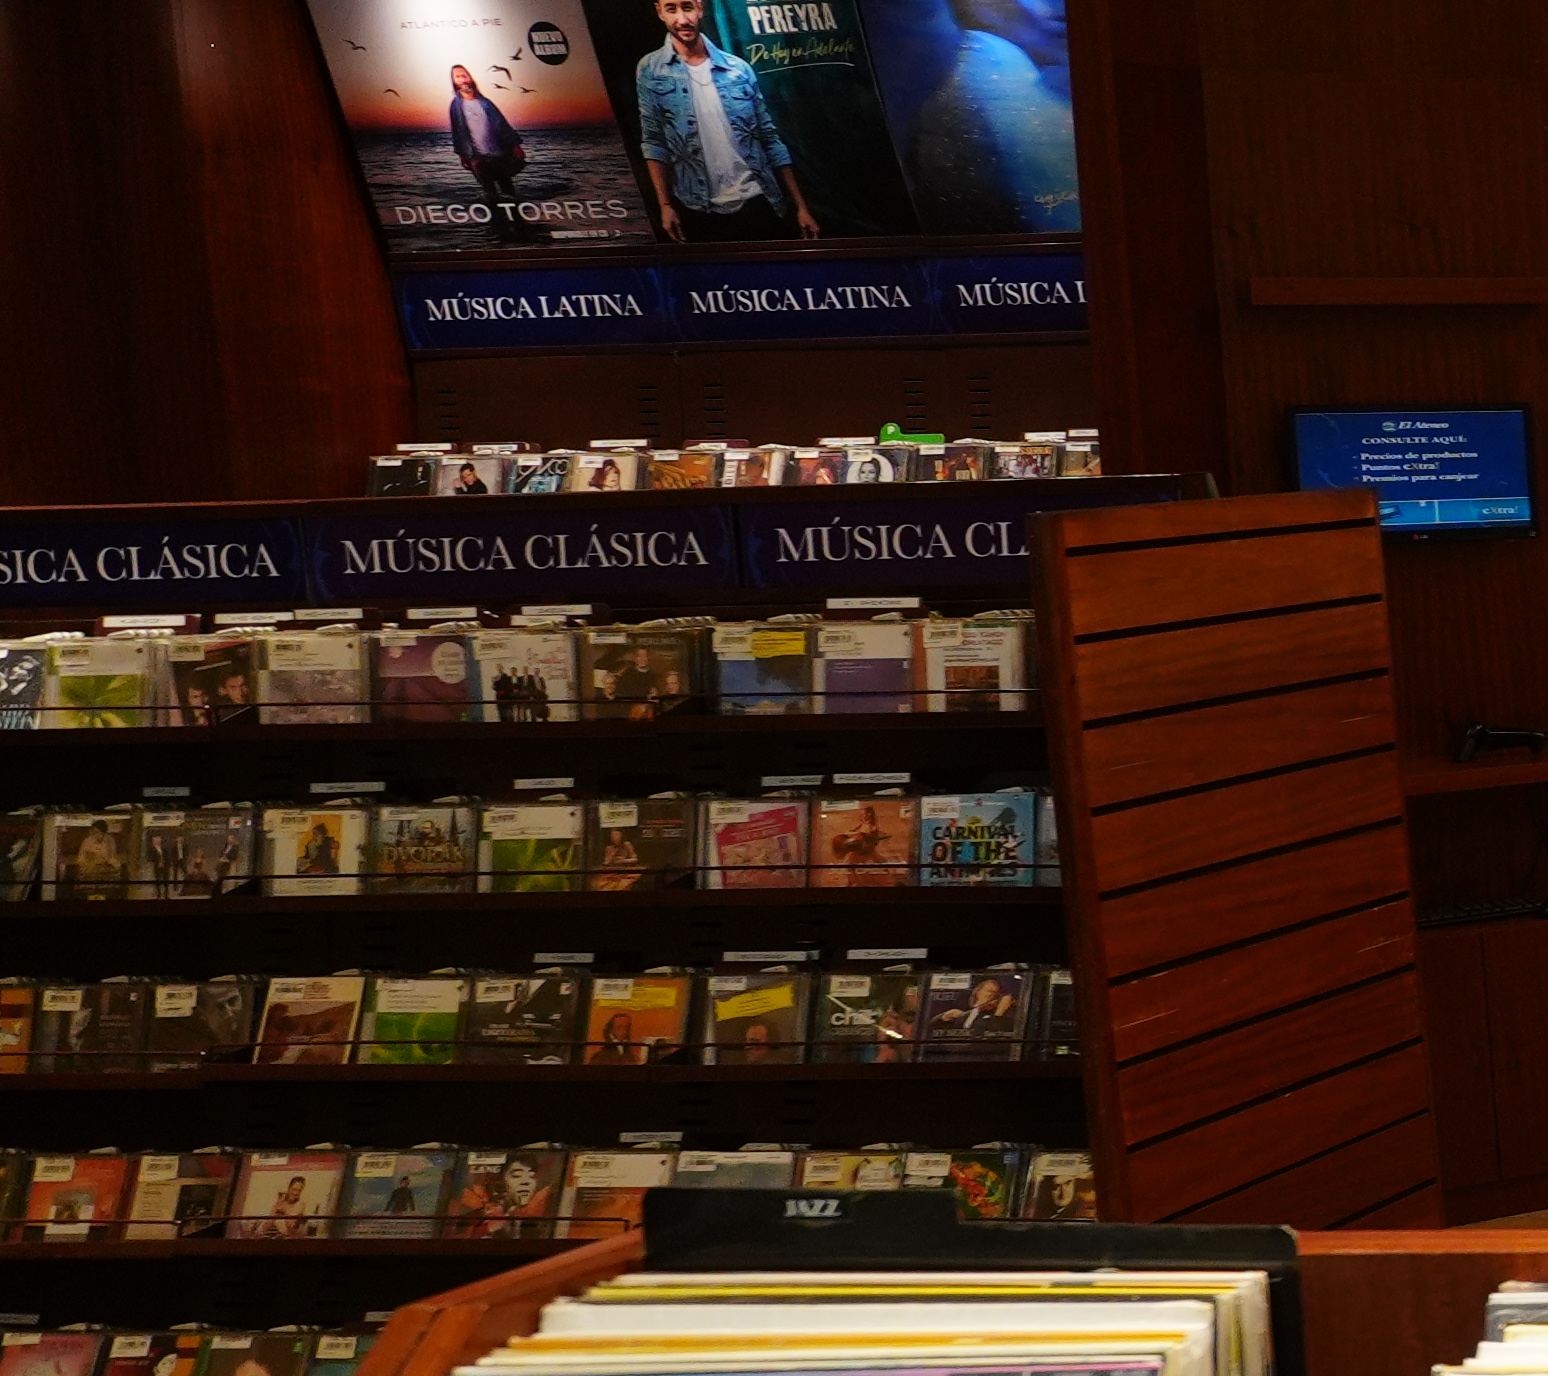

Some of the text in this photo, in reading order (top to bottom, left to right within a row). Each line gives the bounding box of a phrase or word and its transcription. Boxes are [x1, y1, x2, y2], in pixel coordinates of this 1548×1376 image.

[747, 3, 839, 35] PEREYRA
[394, 200, 629, 225] DIEGO TORRES
[690, 285, 911, 314] MÚSICA LATINA
[956, 277, 1069, 307] MÚSICA
[425, 292, 643, 322] MÚSICA LATINA
[1362, 436, 1429, 445] CONSULTE
[1360, 451, 1478, 462] Precios de productos
[1412, 472, 1480, 484] para canjear
[341, 524, 710, 575] MÚSICA CLÁSICA
[776, 516, 955, 564] MÚSICA
[97, 537, 280, 583] CLÁSICA
[784, 1198, 842, 1218] JAZZ
